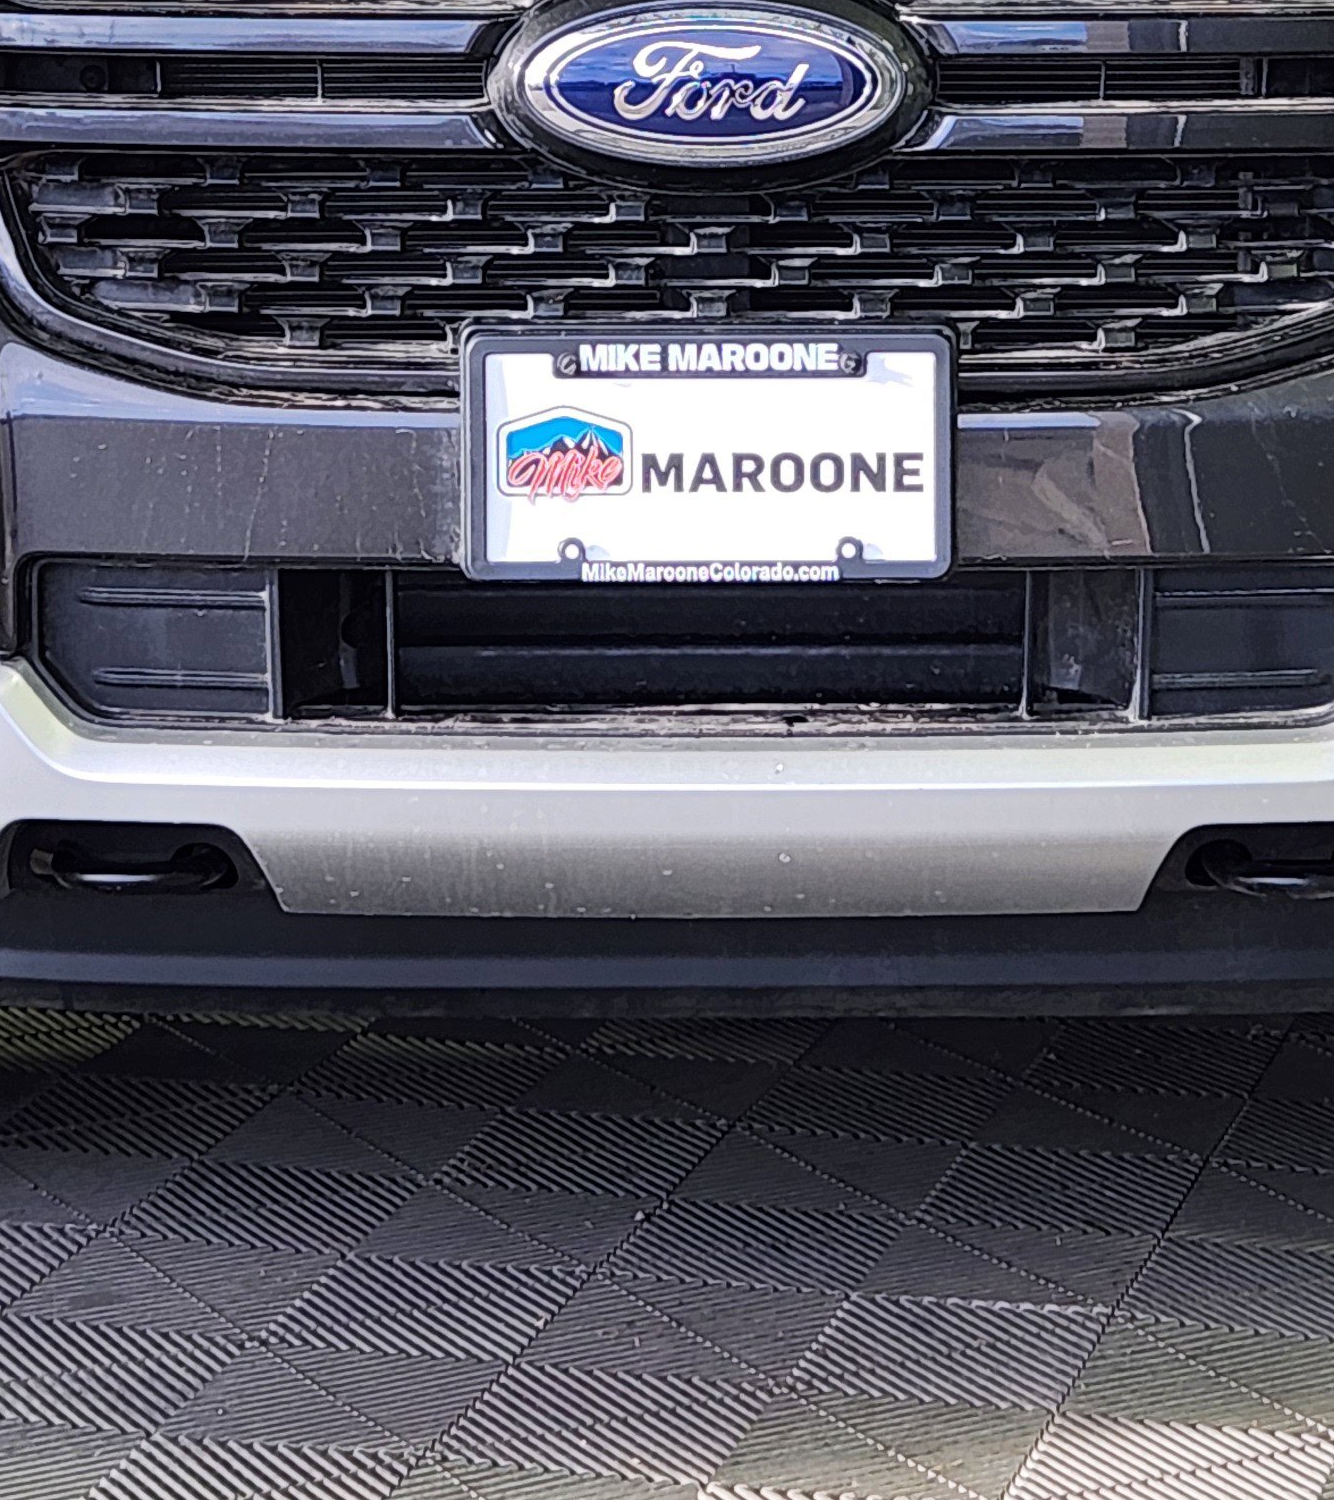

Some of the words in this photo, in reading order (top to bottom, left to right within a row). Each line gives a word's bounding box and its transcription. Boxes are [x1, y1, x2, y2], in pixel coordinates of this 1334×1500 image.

[614, 40, 810, 121] Ford
[579, 343, 662, 372] MIKE
[667, 342, 839, 371] MAROONE
[508, 445, 623, 506] Mike
[641, 452, 925, 494] MAROONE
[581, 561, 840, 583] MikeMarooneColorado.com
